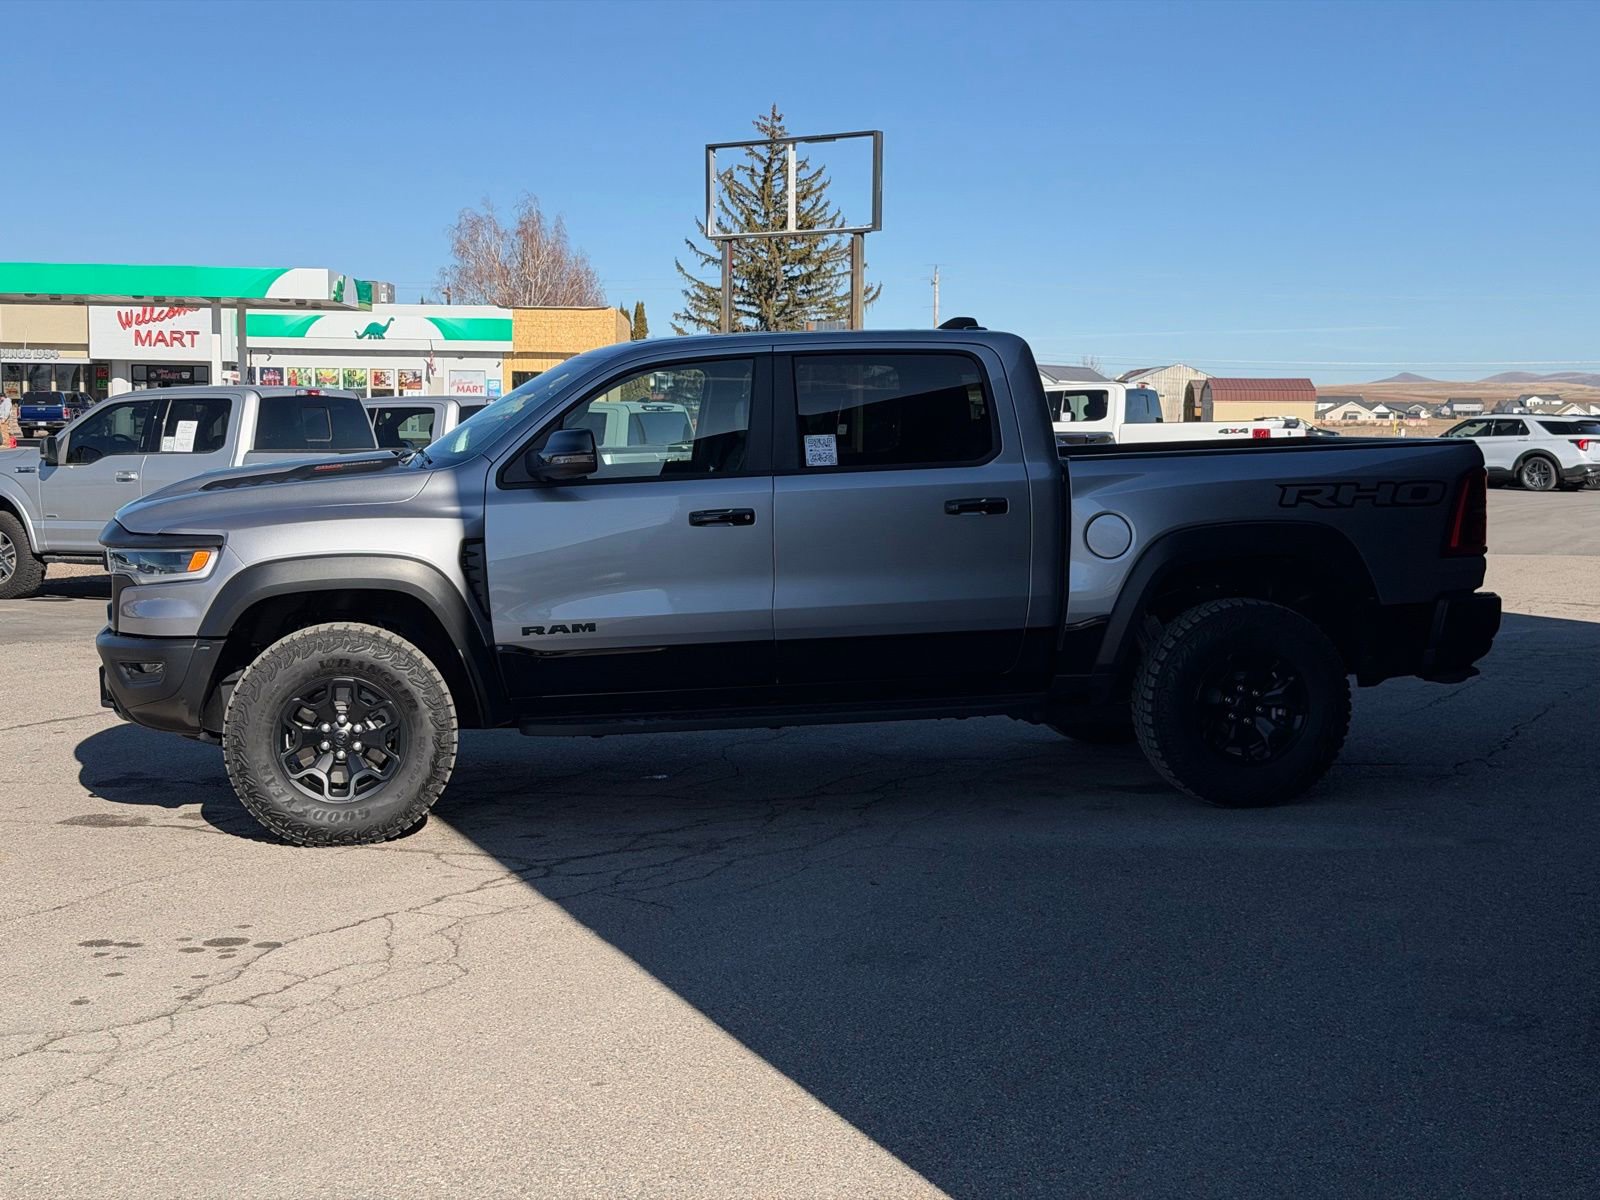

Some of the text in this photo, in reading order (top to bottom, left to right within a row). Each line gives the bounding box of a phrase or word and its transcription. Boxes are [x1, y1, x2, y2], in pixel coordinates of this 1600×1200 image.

[134, 329, 200, 348] MART
[456, 384, 484, 394] MART
[1274, 480, 1448, 509] RHO
[521, 622, 597, 636] RAM
[317, 658, 420, 711] WRANGLER
